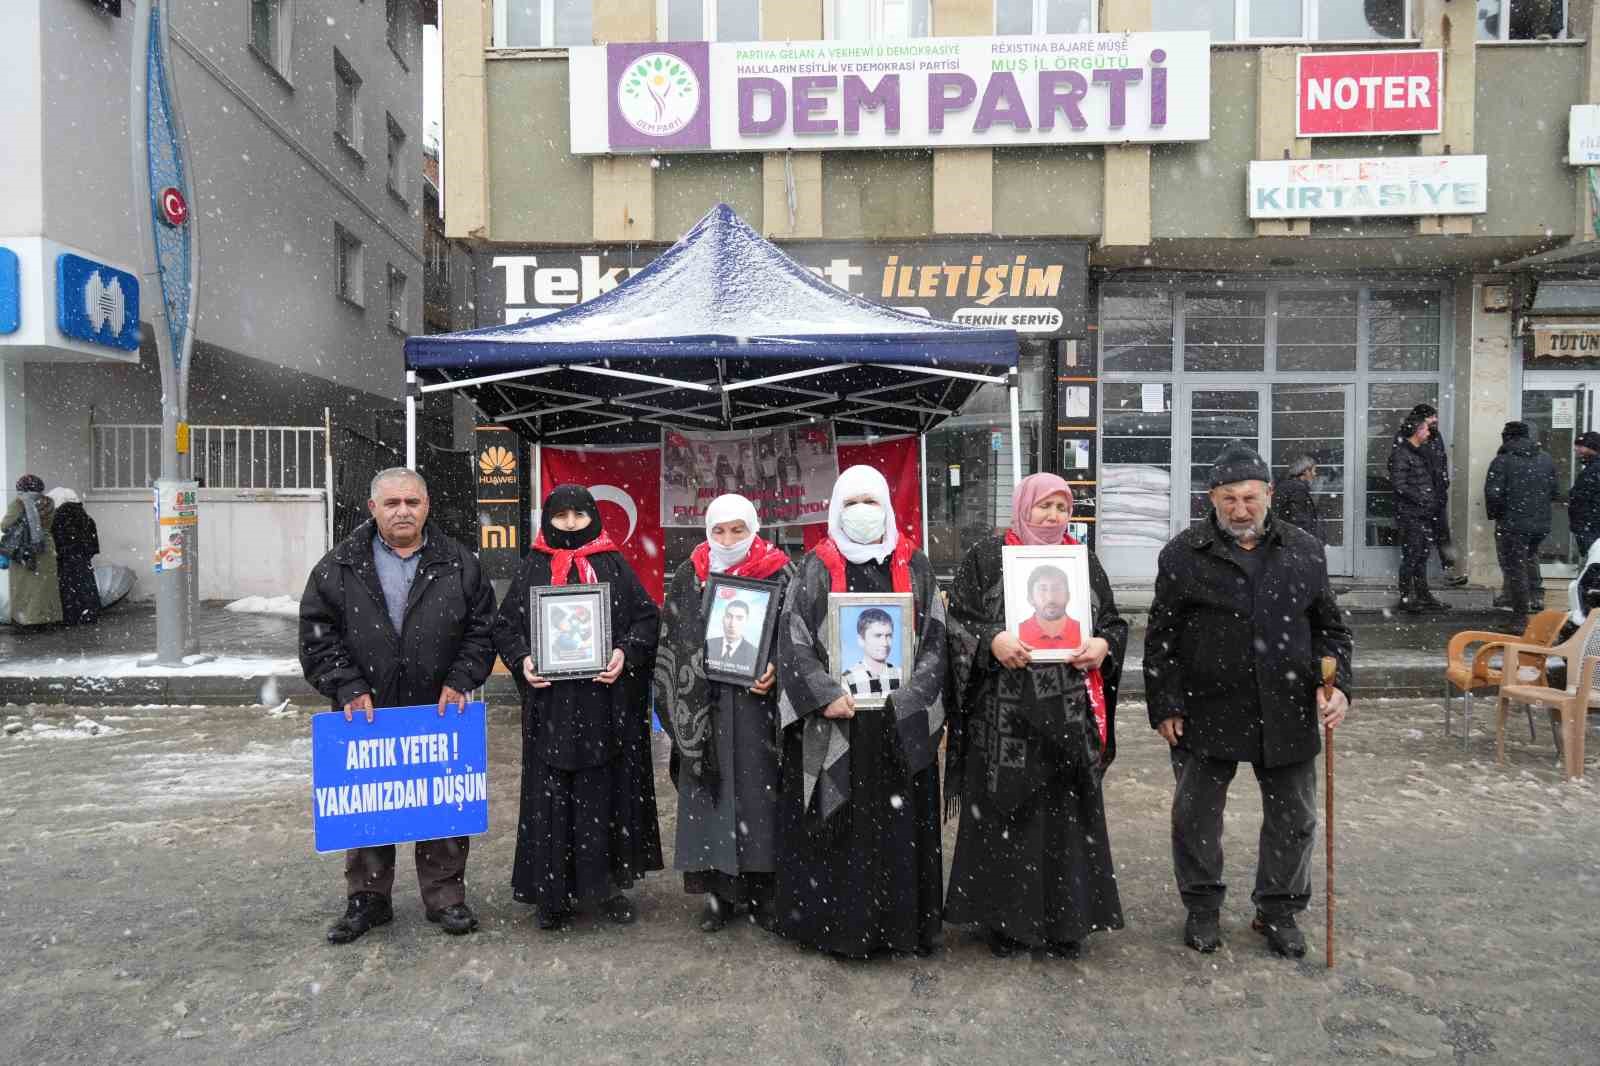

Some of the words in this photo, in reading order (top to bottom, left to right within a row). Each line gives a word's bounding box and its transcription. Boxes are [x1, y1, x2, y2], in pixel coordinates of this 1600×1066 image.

[736, 63, 797, 75] HALKLARIN
[799, 61, 838, 75] EŞİTLİK
[840, 62, 854, 73] VE
[856, 59, 916, 73] DEMOKRASİ
[919, 58, 961, 71] PARTİSİ
[991, 57, 1029, 72] MUŞ
[1034, 56, 1049, 70] İL
[1055, 53, 1129, 70] ÖRGÜTÜ
[738, 72, 898, 136] DEM
[928, 49, 1168, 132] PARTİ
[1306, 75, 1432, 111] NOTER
[1255, 182, 1480, 210] KIRTASİYE
[881, 255, 1064, 305] İLETİŞİM
[956, 311, 1008, 327] TEKNİK
[1010, 310, 1061, 326] SERVİS
[478, 474, 517, 486] HUAWEI
[345, 736, 398, 771] ARTIK
[400, 733, 449, 767] YETER
[315, 778, 429, 818] YAKAMIZDAN
[432, 764, 488, 812] DÜŞÜN
